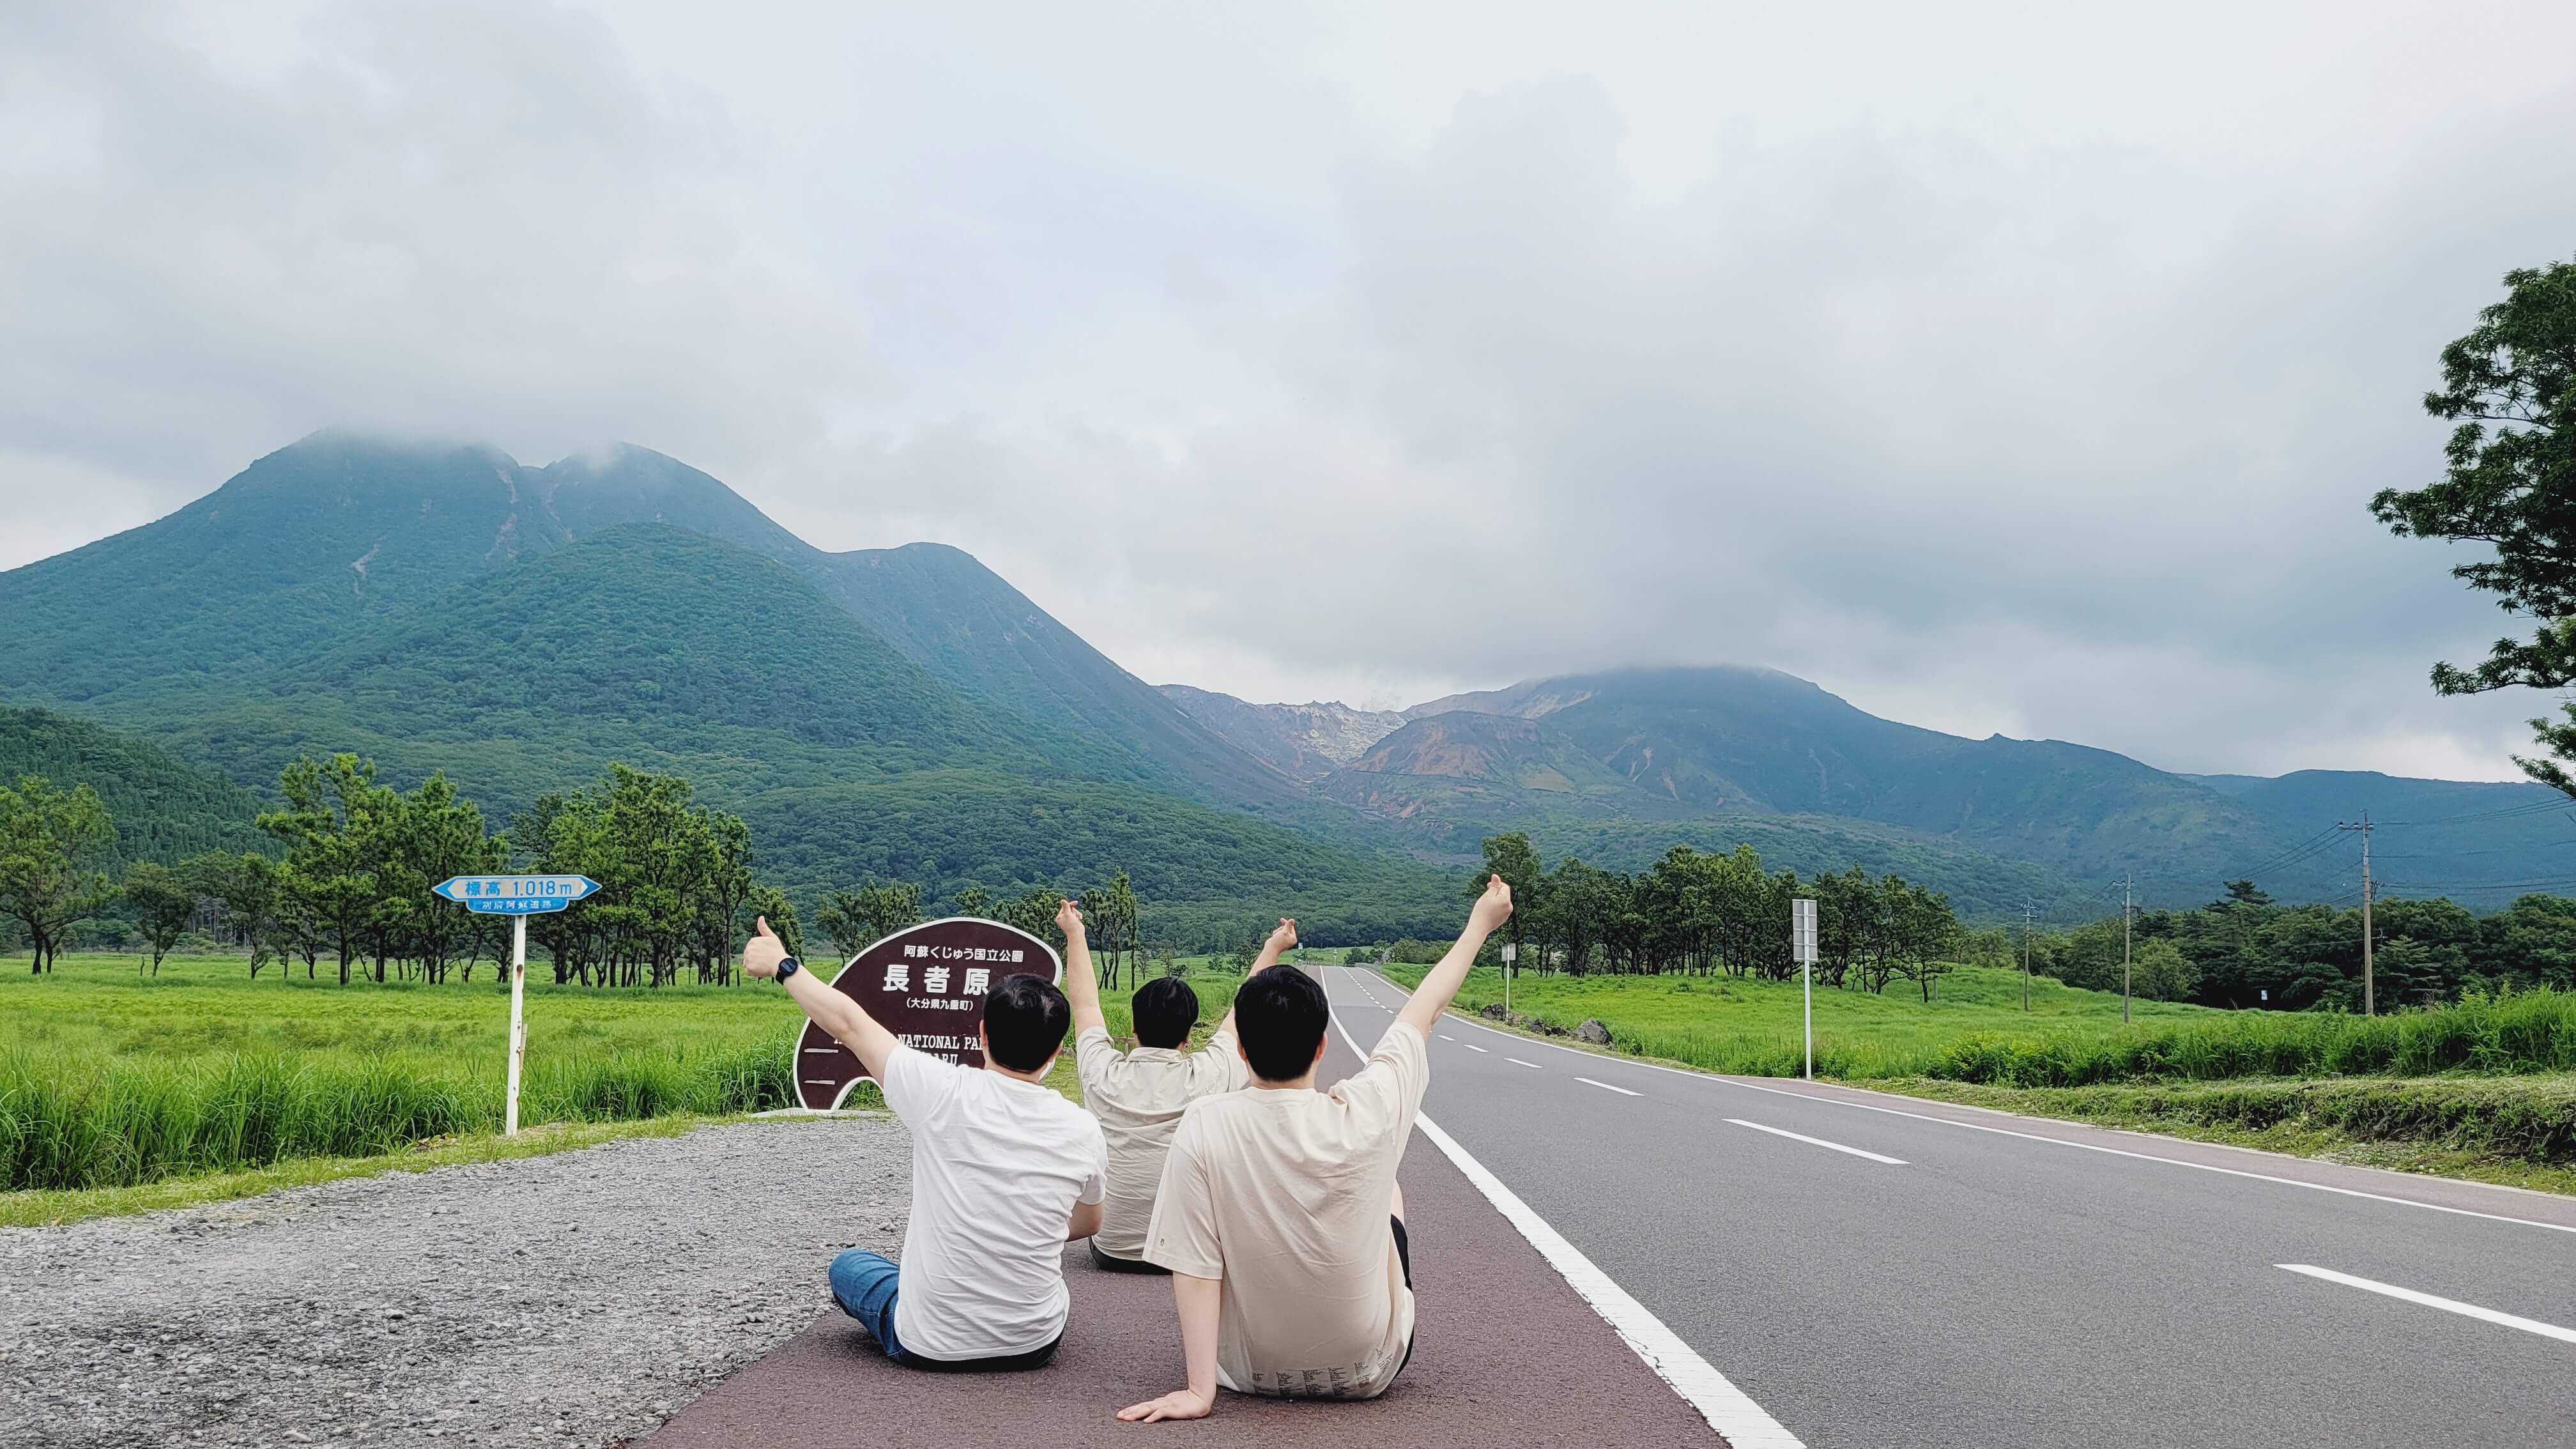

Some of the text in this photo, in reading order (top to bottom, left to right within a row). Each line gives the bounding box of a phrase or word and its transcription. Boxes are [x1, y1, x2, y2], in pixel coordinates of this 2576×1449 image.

[465, 881, 502, 896] 標高
[904, 945, 1023, 962] 阿蘇くじゅう国立公園
[882, 964, 990, 996] 長者原
[898, 1034, 960, 1050] NATIONAL
